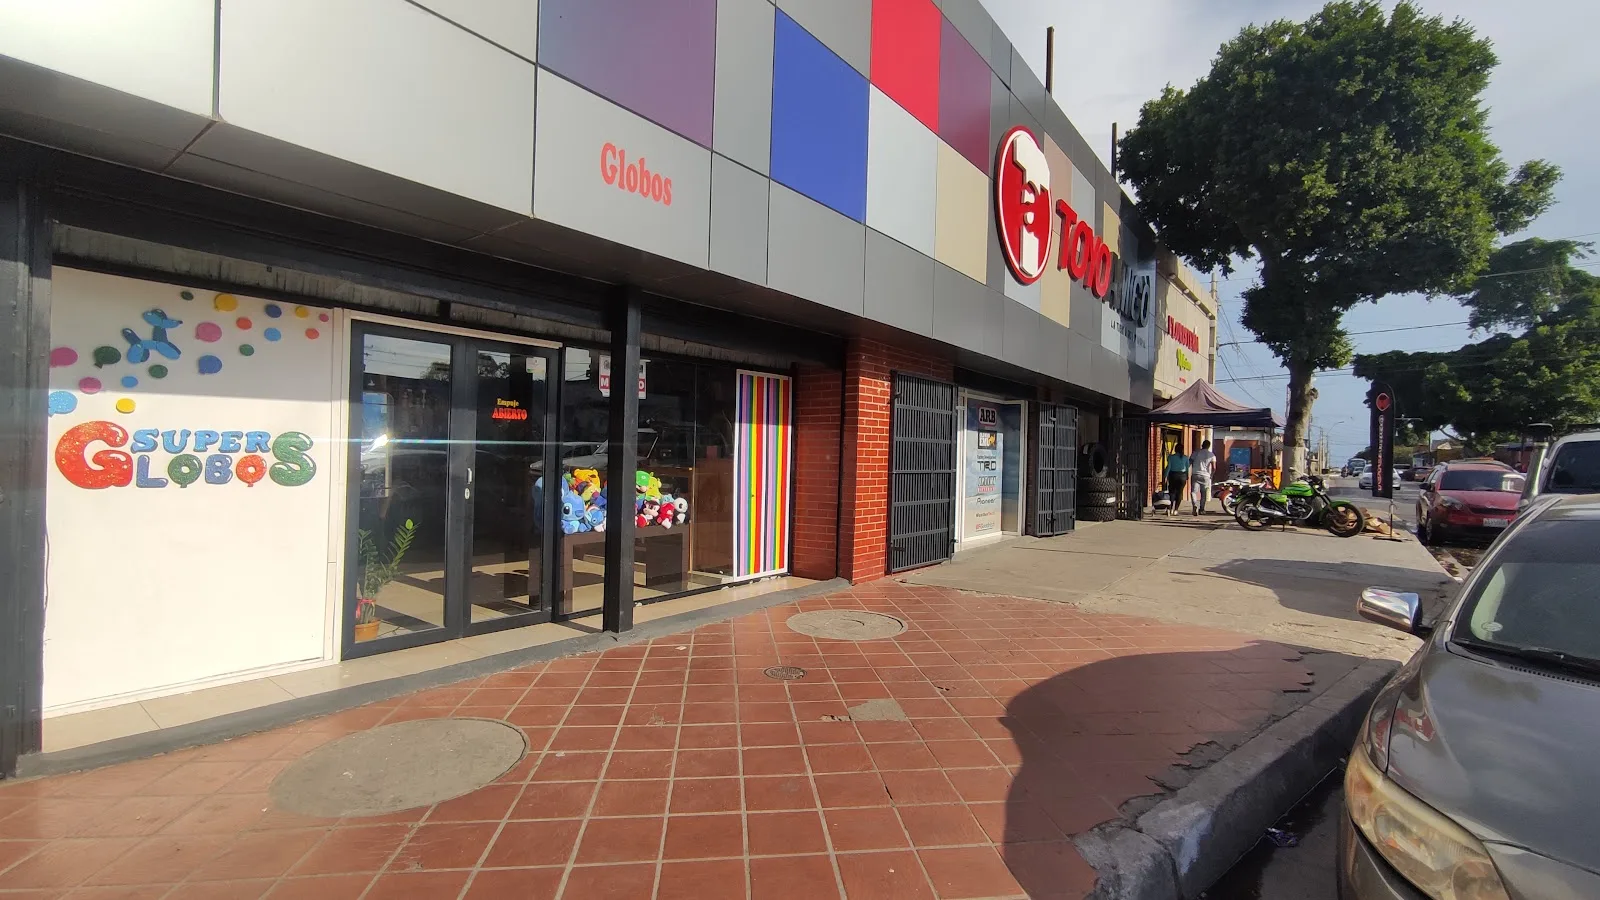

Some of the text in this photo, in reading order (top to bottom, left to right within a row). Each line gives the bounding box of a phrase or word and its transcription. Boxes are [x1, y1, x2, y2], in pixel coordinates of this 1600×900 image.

[600, 142, 672, 206] Globos
[497, 398, 519, 408] Empuje
[492, 407, 527, 419] ABIERTO
[980, 408, 996, 423] ARB
[131, 428, 271, 454] SUPER
[55, 420, 317, 490] GLOBOS
[977, 460, 996, 471] TRD
